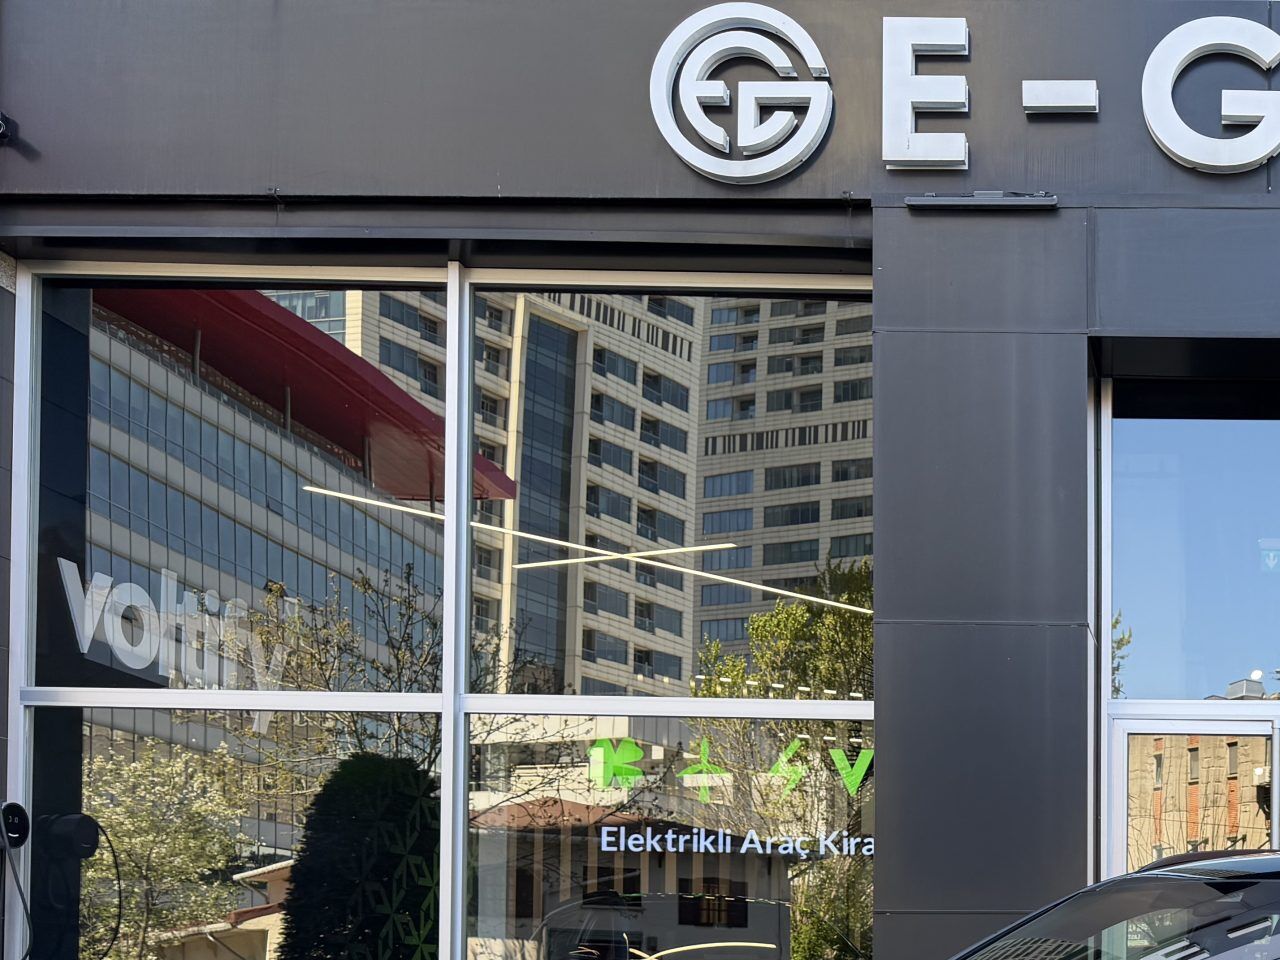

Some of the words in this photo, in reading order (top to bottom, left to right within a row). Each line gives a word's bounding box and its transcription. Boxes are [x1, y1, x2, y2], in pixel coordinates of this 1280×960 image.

[600, 826, 732, 852] Elektrikli
[741, 830, 810, 859] Araç
[818, 832, 875, 856] Kira
